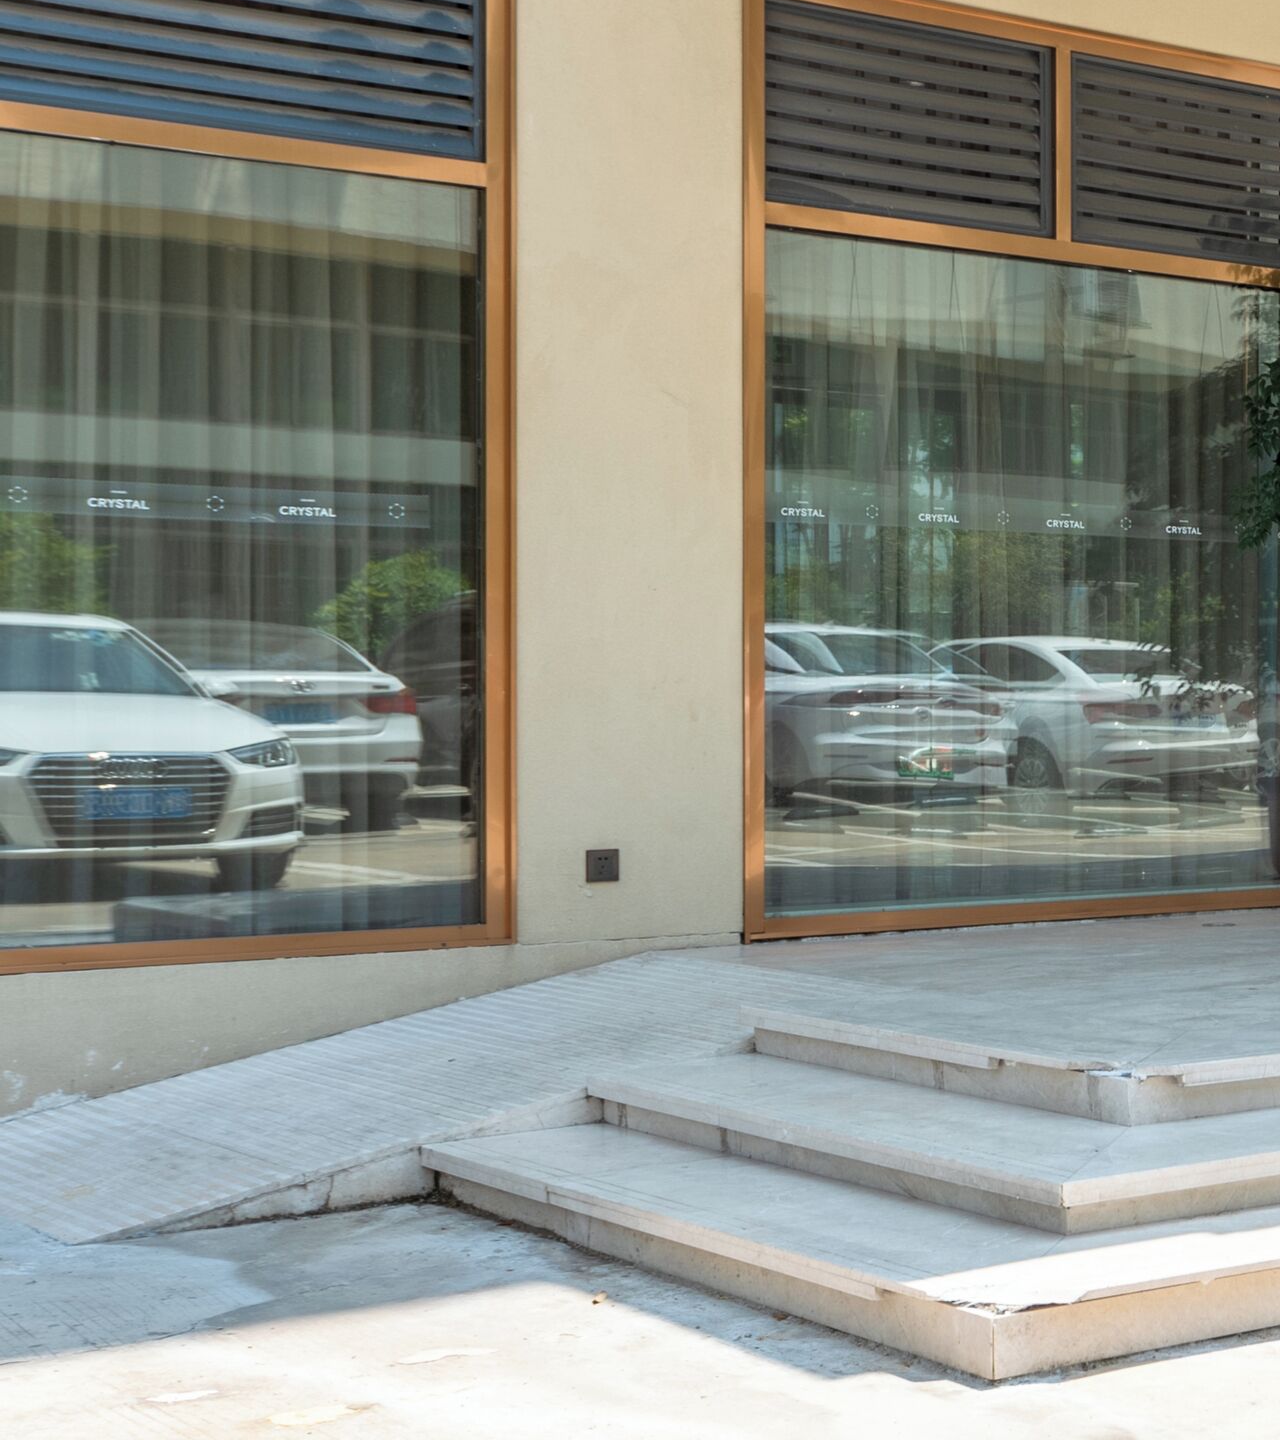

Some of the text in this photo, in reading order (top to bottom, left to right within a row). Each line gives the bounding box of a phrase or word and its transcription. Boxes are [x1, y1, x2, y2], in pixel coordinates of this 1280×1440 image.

[87, 497, 151, 510] CRYSTAL
[279, 505, 337, 517] CRYSTAL
[781, 507, 825, 518] CRYSTAL
[918, 513, 960, 523] CRYSTAL
[1046, 519, 1085, 529] CRYSTAL
[1165, 525, 1202, 535] CRYSTAL
